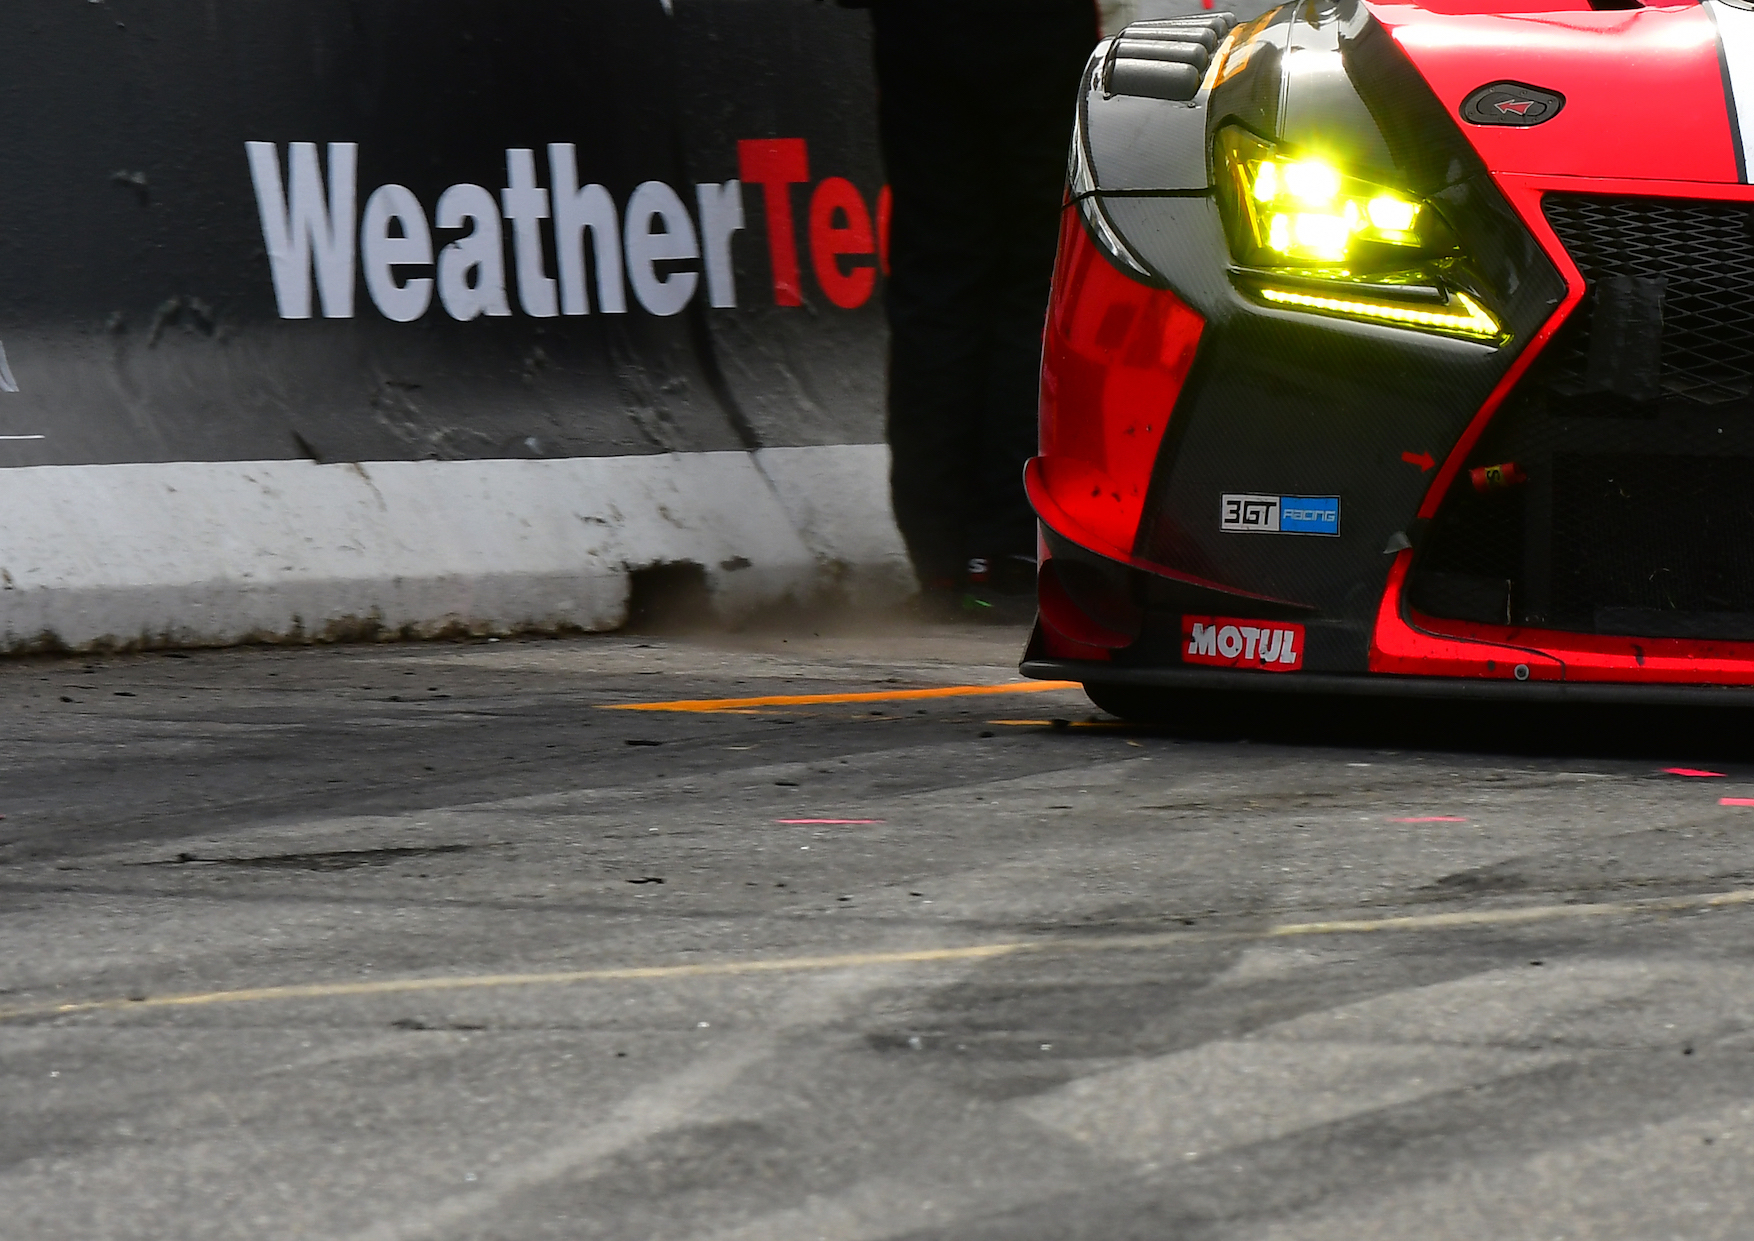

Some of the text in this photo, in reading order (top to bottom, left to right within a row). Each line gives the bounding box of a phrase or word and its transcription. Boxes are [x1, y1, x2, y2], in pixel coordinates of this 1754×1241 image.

[244, 137, 893, 323] WeatherTe
[1224, 500, 1277, 525] 3GT
[1188, 622, 1297, 664] MOTUL
